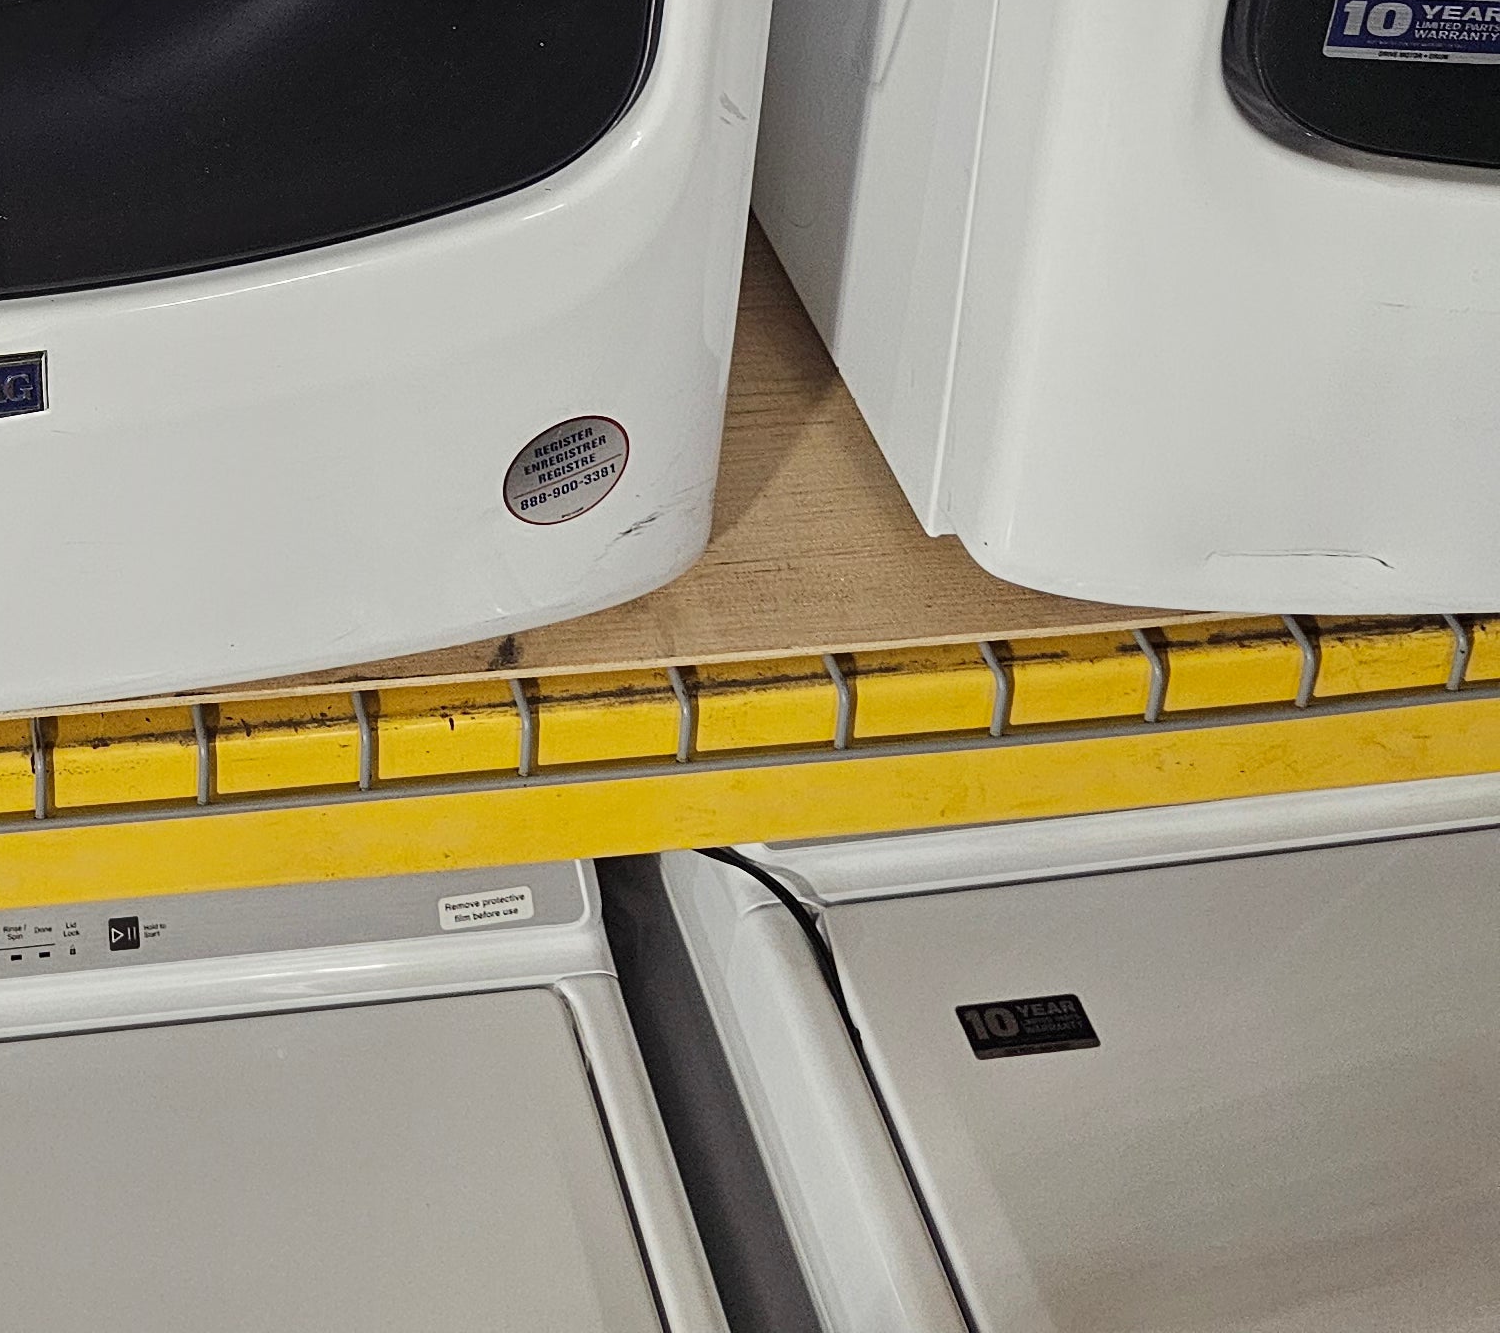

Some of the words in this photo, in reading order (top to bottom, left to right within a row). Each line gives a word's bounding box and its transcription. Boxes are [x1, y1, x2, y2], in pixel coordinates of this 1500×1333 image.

[1343, 0, 1413, 37] 10
[1422, 4, 1500, 22] YEAR
[1414, 29, 1500, 42] WARRANTY
[1415, 21, 1461, 31] LIMITED
[523, 434, 607, 475] ENREGISTRER
[534, 427, 593, 458] REGISTER
[538, 453, 597, 484] REGISTRE
[520, 462, 616, 511] 888-900-3381
[445, 900, 481, 912] Remove
[482, 893, 525, 908] protective
[454, 914, 472, 923] film
[473, 910, 501, 920] before
[502, 907, 519, 916] use
[1015, 1000, 1077, 1017] YEAR
[964, 1007, 1020, 1041] 10
